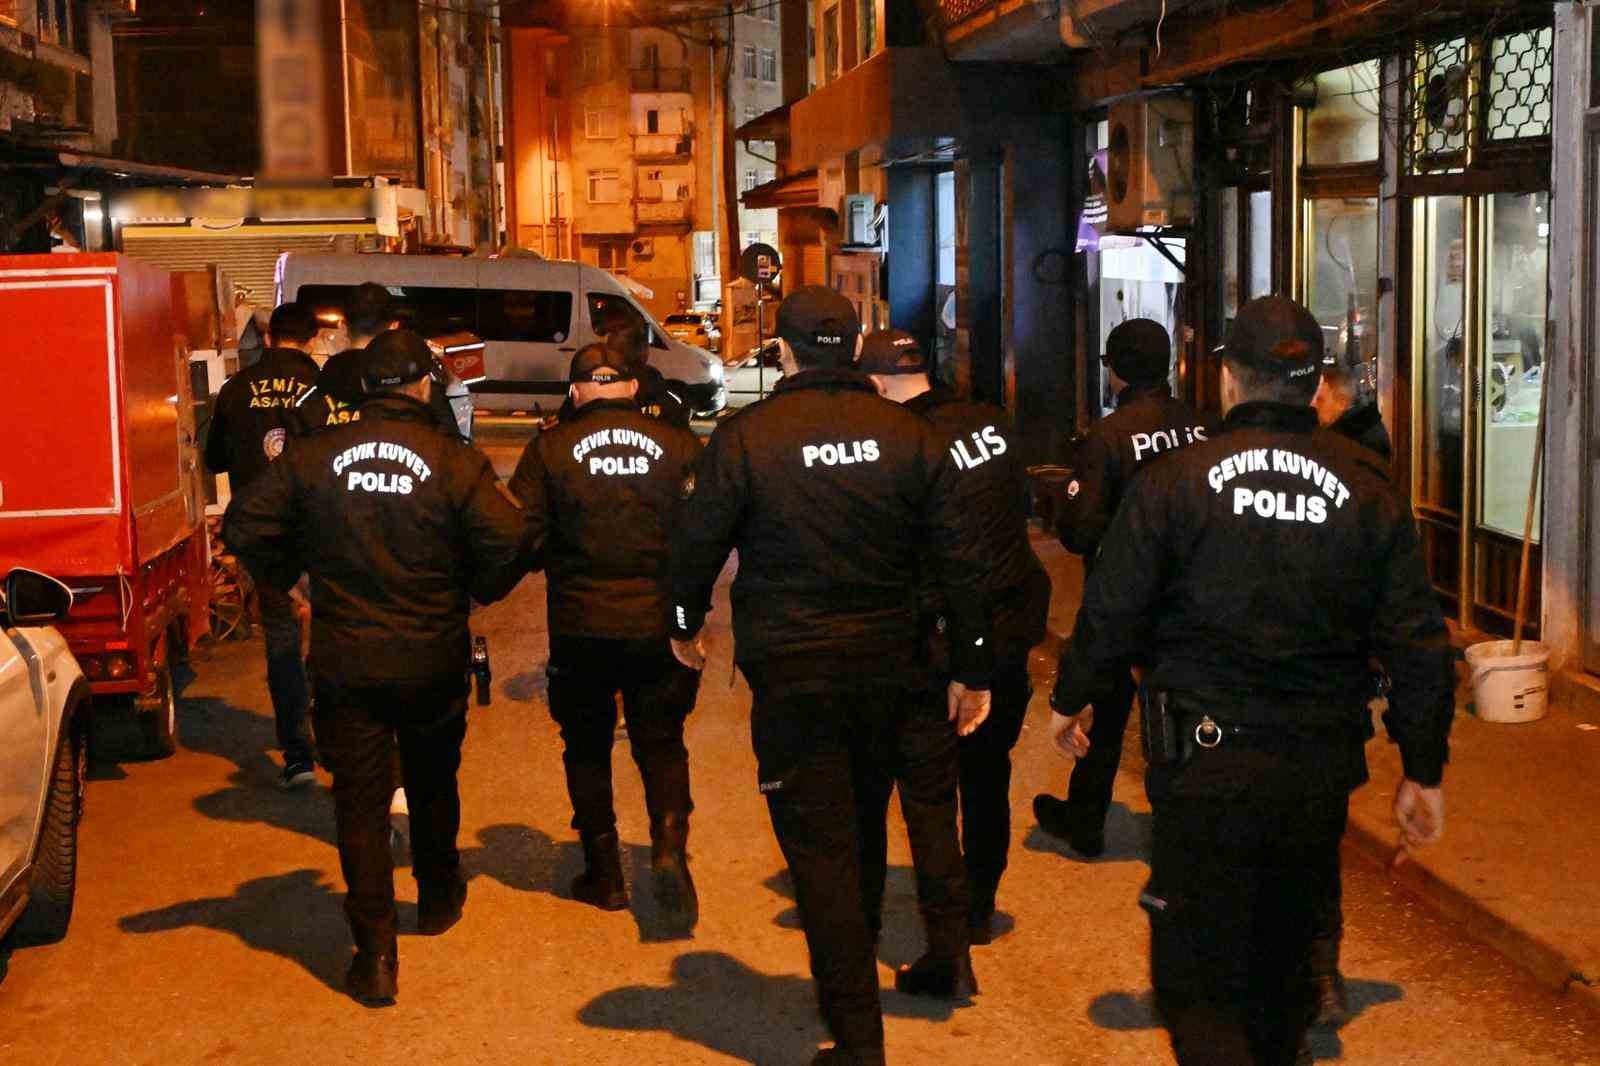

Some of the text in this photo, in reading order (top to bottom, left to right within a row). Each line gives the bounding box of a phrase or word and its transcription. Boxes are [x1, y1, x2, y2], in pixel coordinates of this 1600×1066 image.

[378, 442, 431, 482] KUVVET
[612, 428, 664, 460] KUVVET
[1272, 449, 1350, 508] KUVVET
